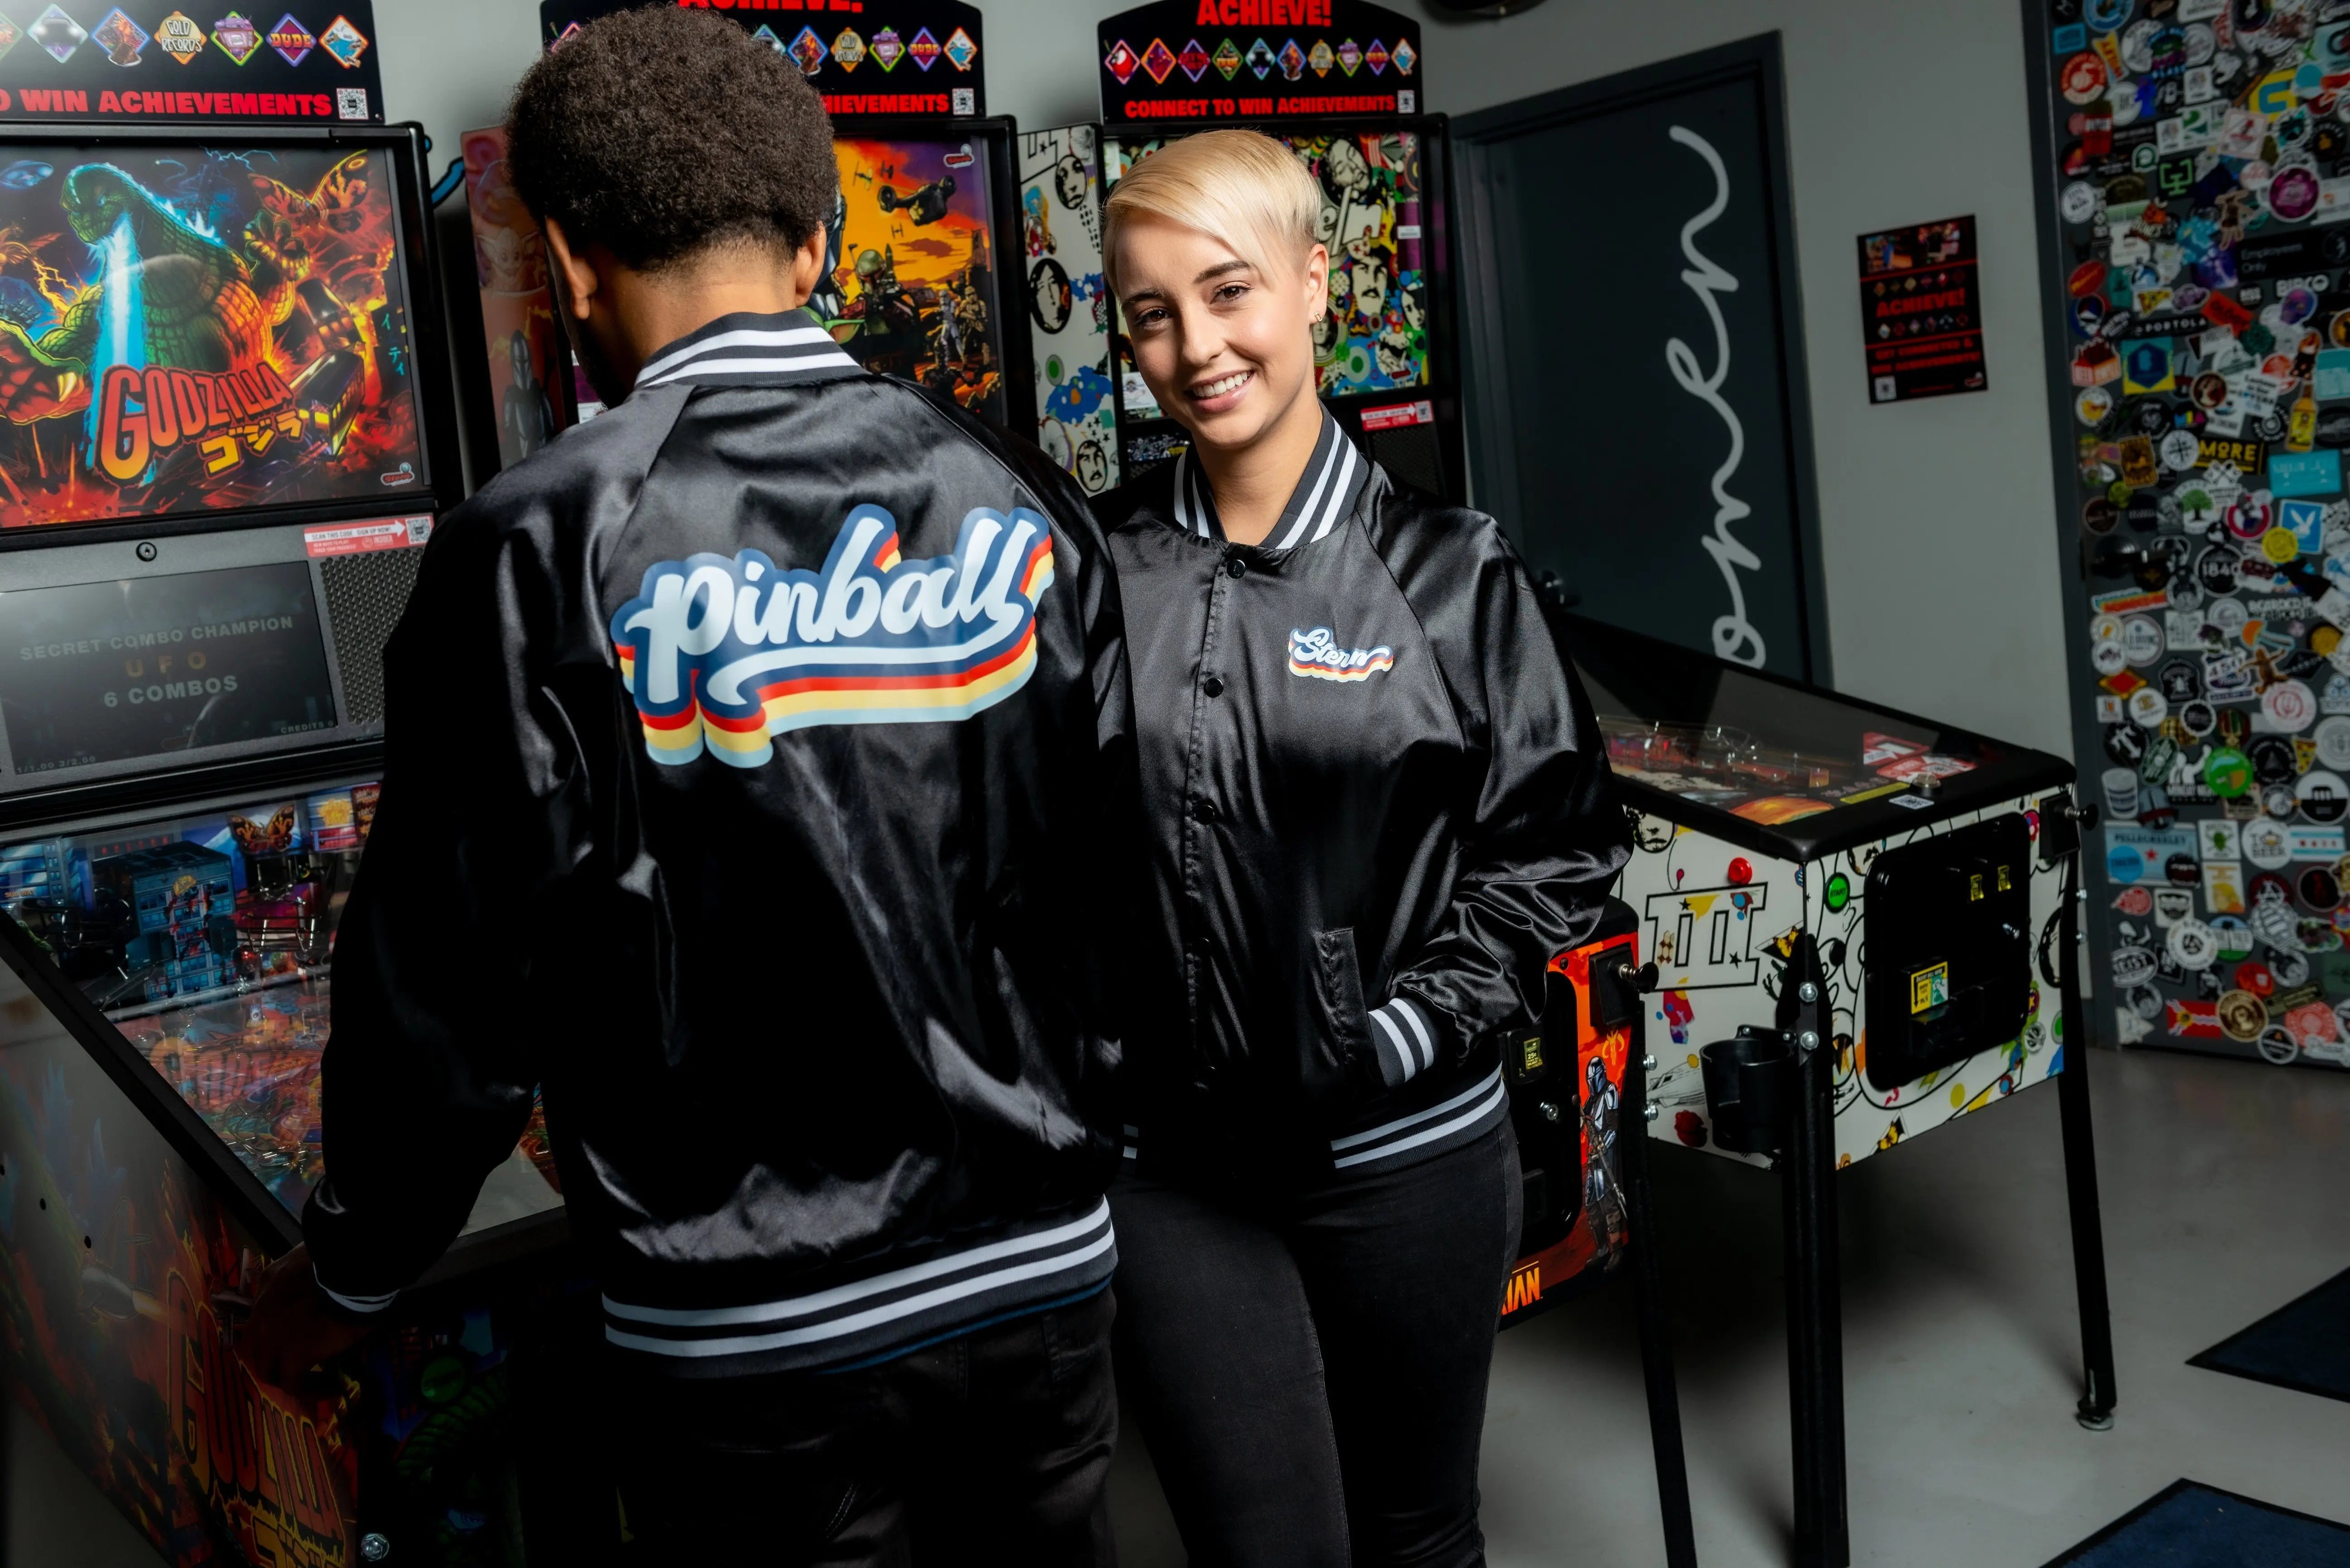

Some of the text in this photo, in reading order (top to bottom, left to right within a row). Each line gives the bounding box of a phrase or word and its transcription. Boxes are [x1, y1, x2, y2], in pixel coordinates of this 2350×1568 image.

[1196, 0, 1332, 26] ACHIEVE!
[166, 20, 191, 36] GOLD
[271, 33, 314, 49] DUDE
[161, 38, 202, 54] RECORDS
[19, 89, 89, 113] WIN
[98, 90, 332, 117] ACHIEVEMENTS
[1125, 95, 1395, 118] CONNECT TO WIN ACHIEVEMENTS
[100, 362, 292, 480] GODZILLA
[200, 410, 302, 474] ゴジラ
[20, 616, 294, 661] SECRET COMBO CHAMPION
[1292, 627, 1391, 669] Stern
[104, 675, 238, 708] 6 COMBOS
[1830, 887, 1847, 900] START
